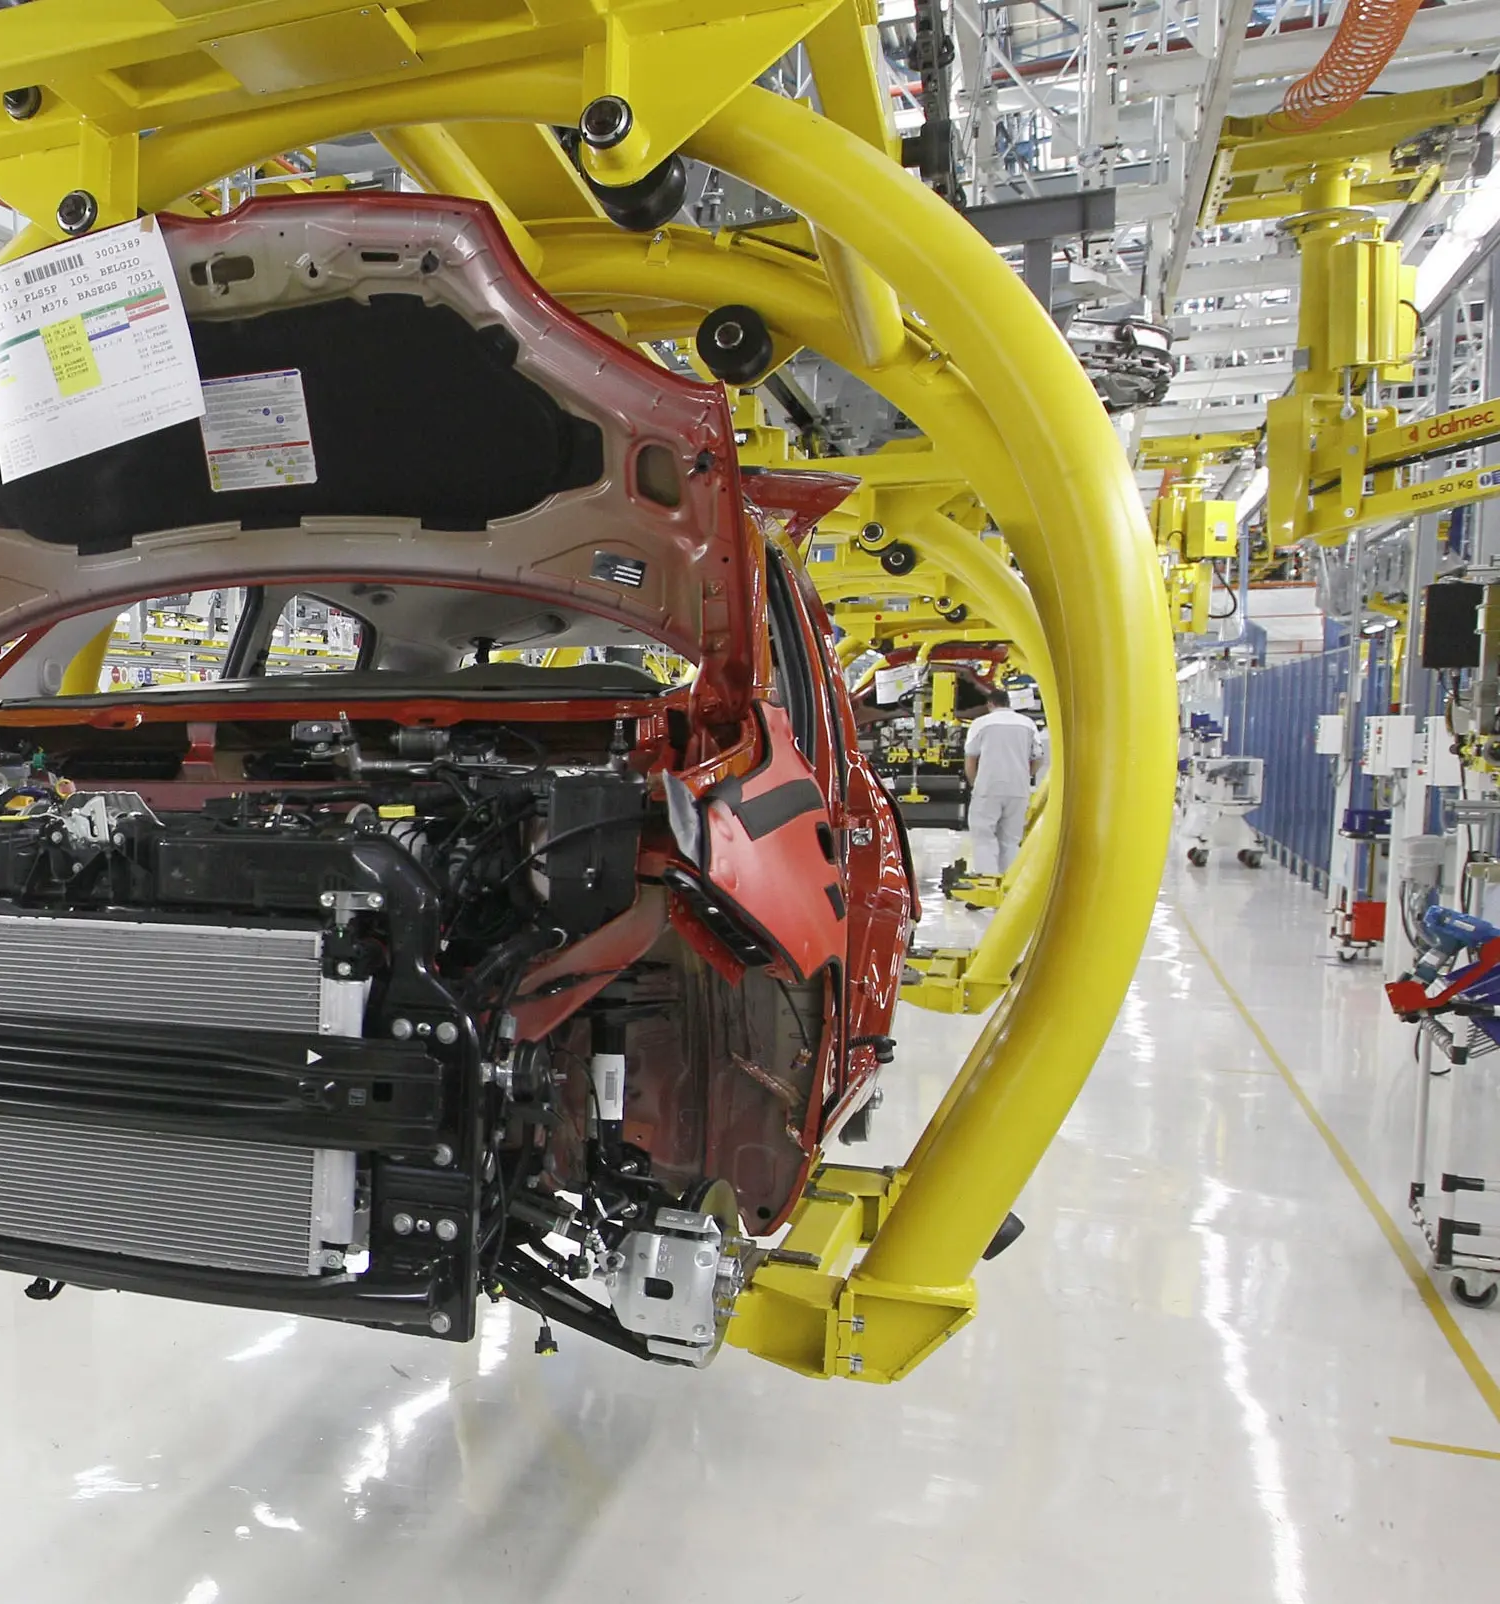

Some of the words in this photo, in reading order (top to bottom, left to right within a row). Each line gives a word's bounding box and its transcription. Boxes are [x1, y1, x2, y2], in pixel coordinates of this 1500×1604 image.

[95, 238, 141, 259] 3001389
[24, 284, 58, 303] PLS5P
[70, 274, 90, 287] 105
[100, 257, 141, 277] BELGIO
[15, 310, 33, 324] 147
[41, 297, 69, 315] M376
[77, 281, 118, 301] BASEGS
[127, 270, 156, 285] 7051
[1428, 411, 1494, 439] dalmec
[1412, 489, 1434, 501] max
[1439, 483, 1453, 494] 50
[1458, 480, 1473, 490] Kg
